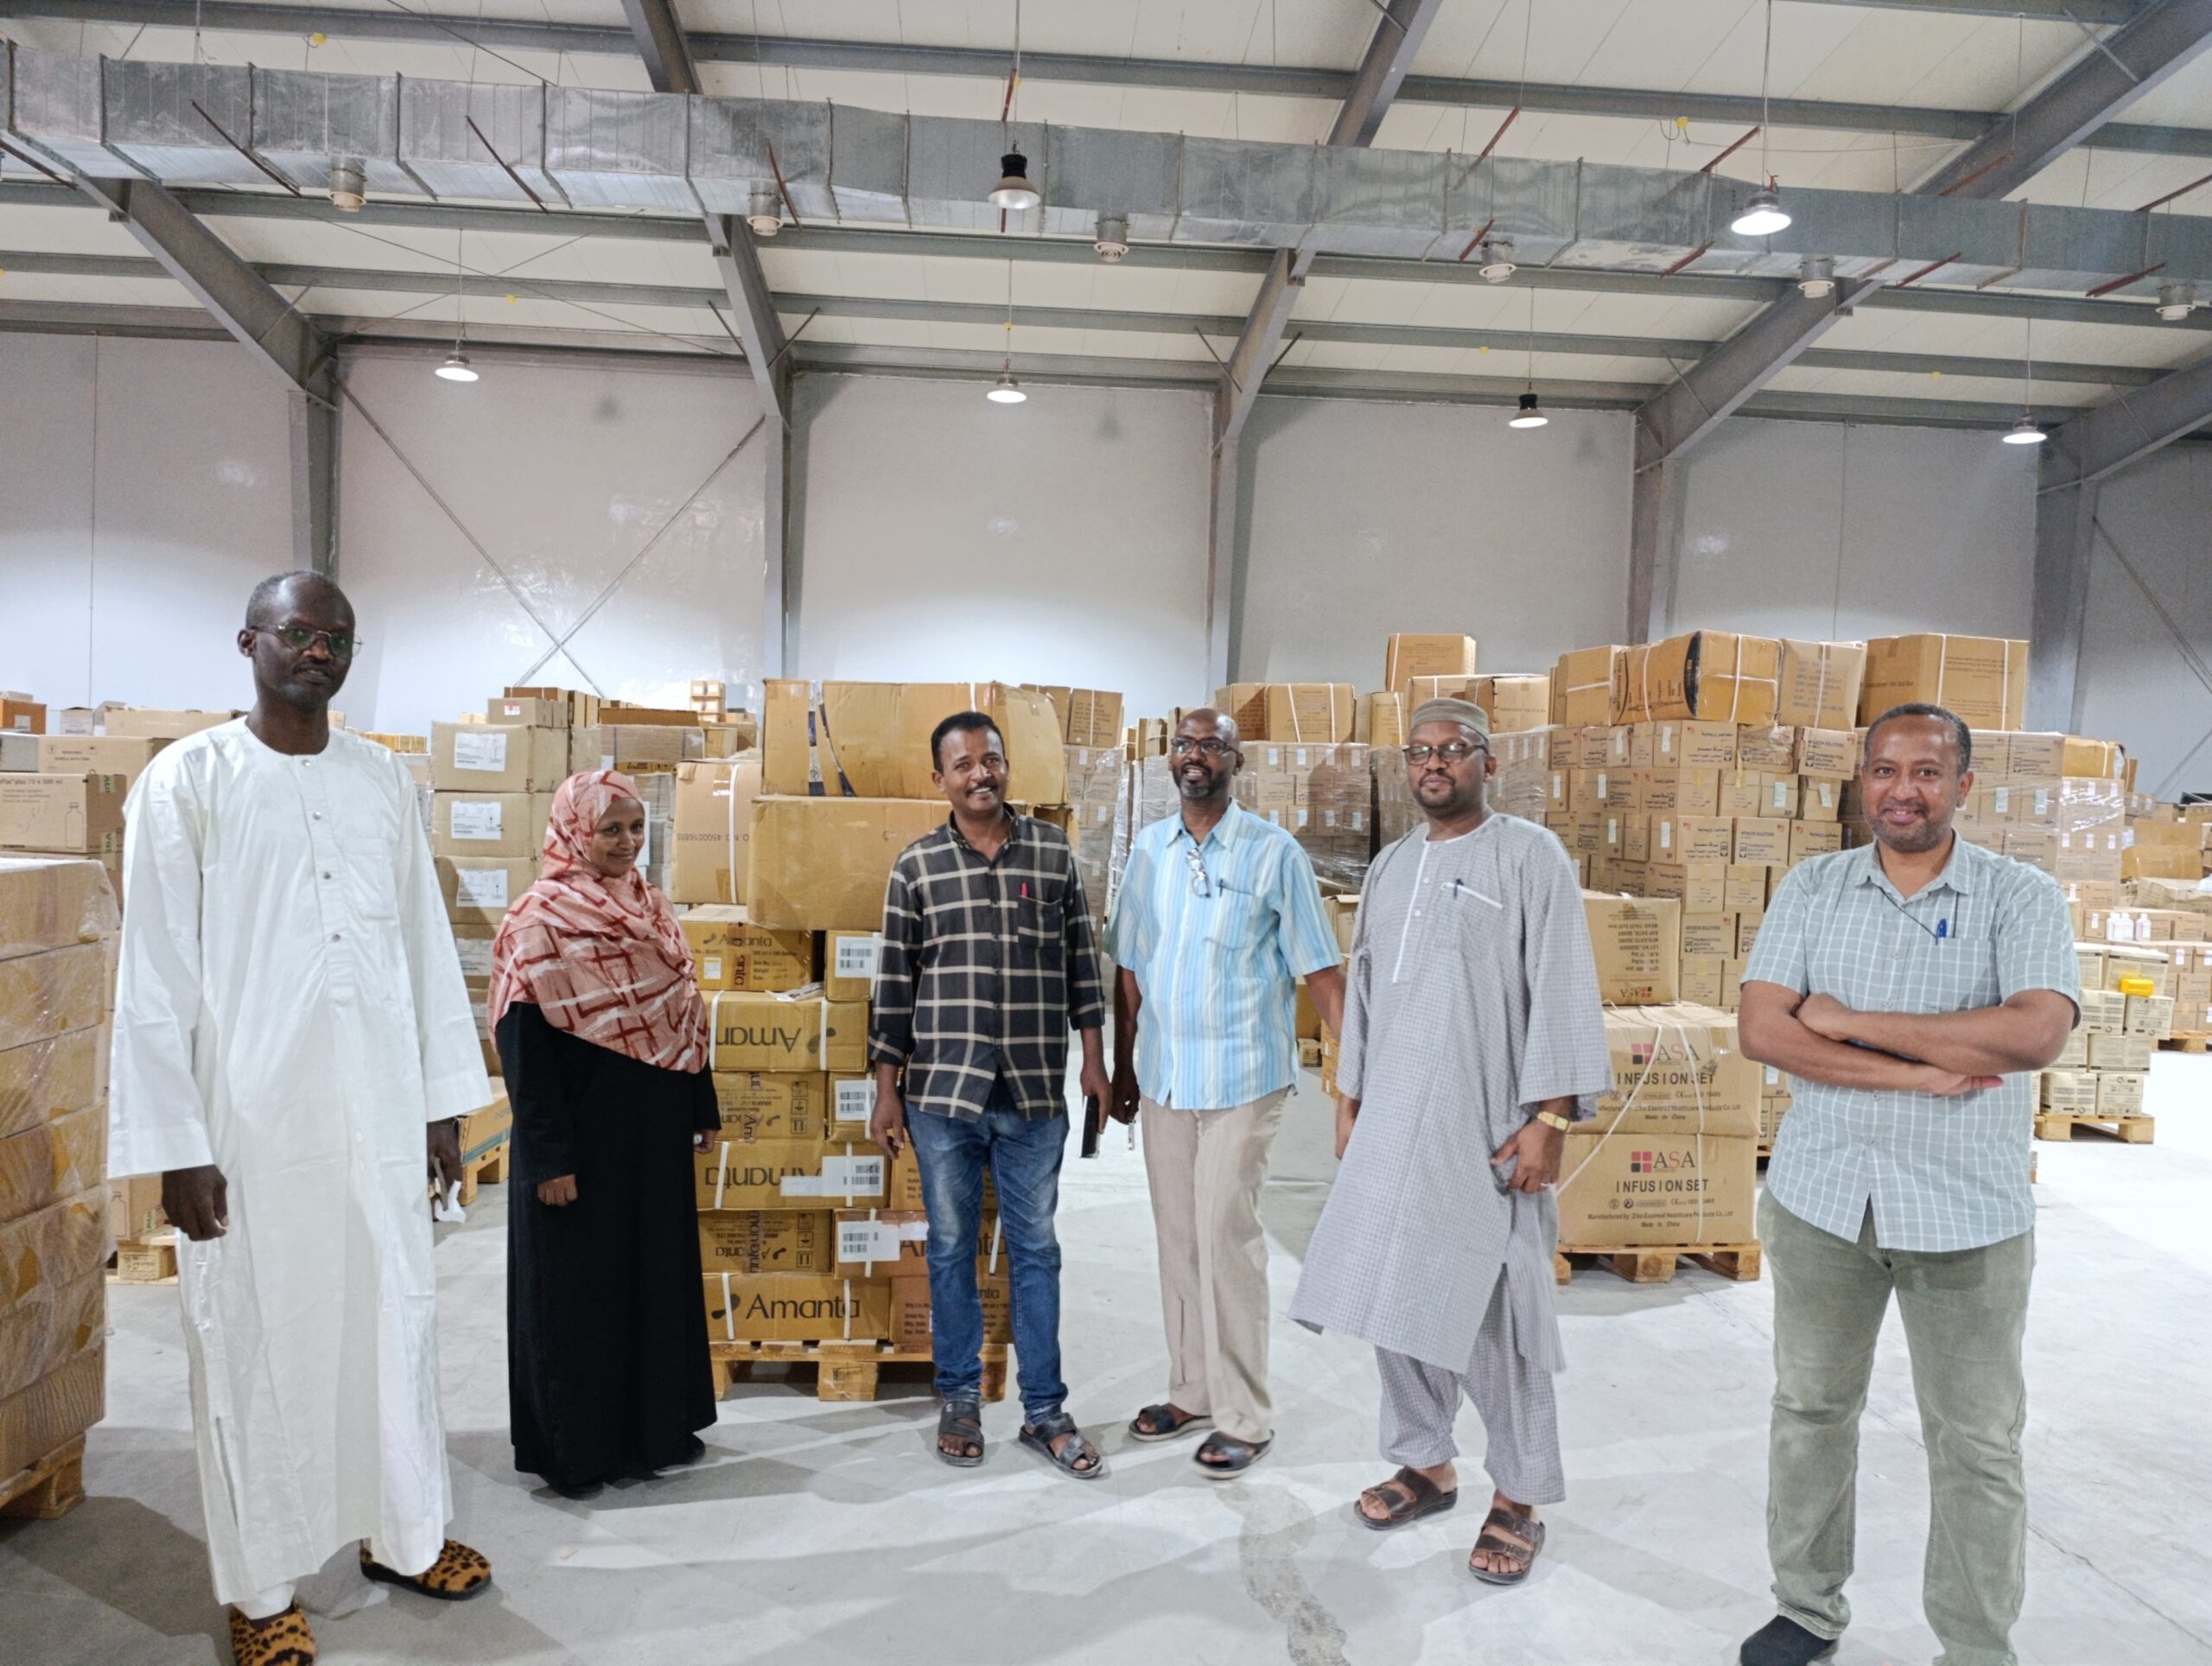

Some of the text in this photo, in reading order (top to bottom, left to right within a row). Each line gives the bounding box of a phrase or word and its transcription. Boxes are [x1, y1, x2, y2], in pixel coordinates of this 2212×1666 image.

[1656, 1044, 1700, 1061] ASA
[1653, 1151, 1696, 1168] ASA
[1616, 1179, 1709, 1192] INFUSION SET
[746, 1293, 861, 1319] Amanta
